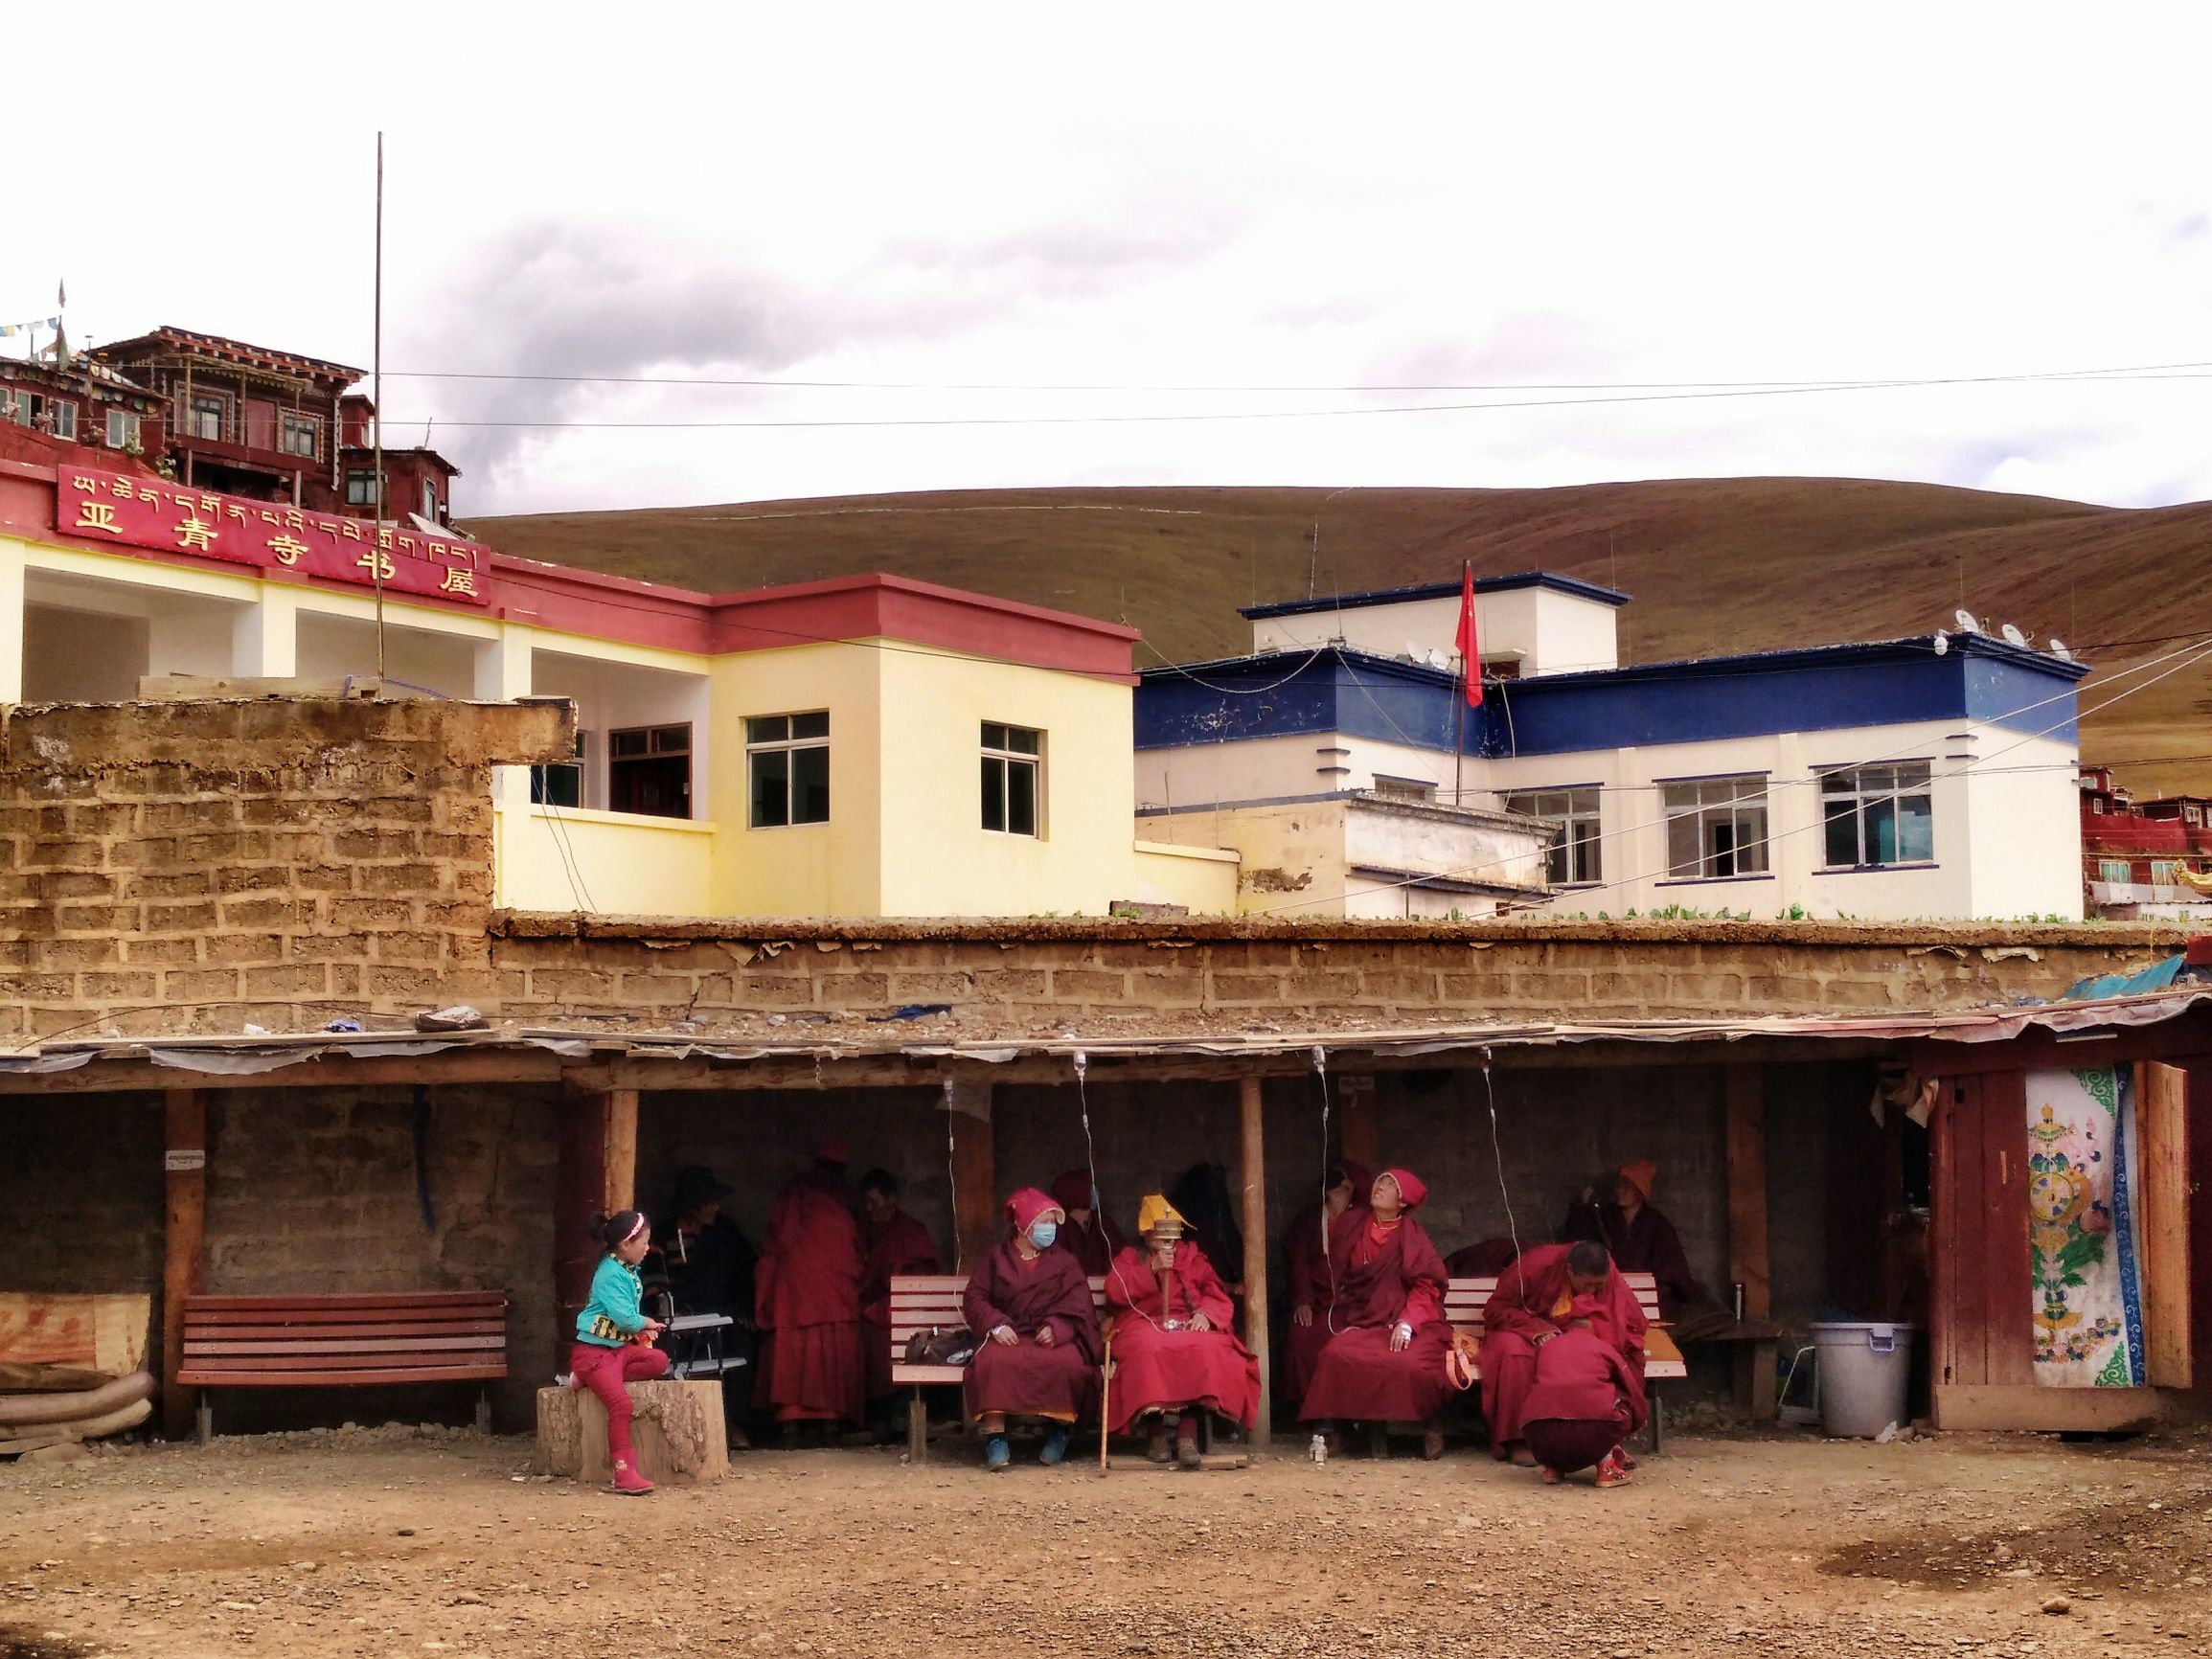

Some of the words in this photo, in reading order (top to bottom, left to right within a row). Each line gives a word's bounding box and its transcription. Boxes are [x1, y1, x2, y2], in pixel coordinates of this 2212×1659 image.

[76, 501, 479, 598] 亚青寺书屋
